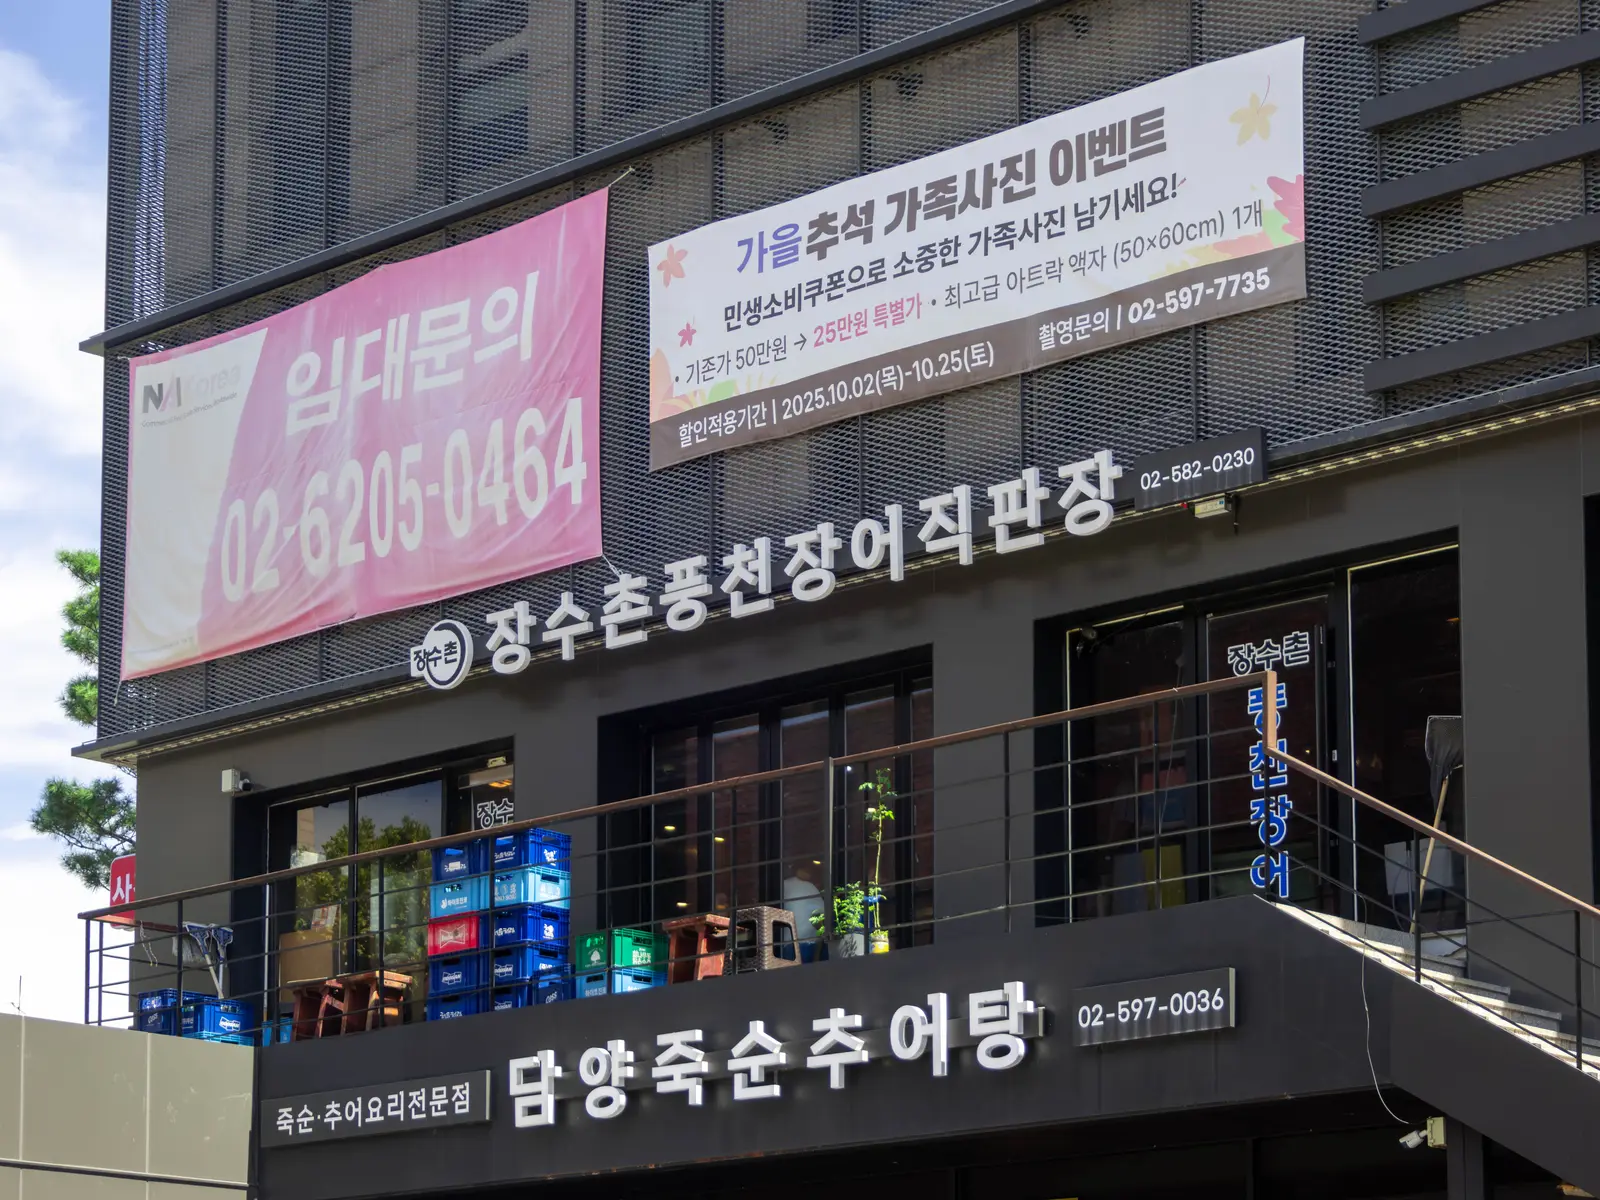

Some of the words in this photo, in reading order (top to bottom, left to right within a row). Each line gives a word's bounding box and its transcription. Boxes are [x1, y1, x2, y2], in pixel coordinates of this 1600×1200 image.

[737, 223, 802, 274] 가을
[806, 199, 875, 261] 추석
[884, 148, 1036, 236] 가족사진
[1049, 106, 1167, 187] 이벤트
[686, 349, 731, 385] 기존가
[735, 335, 787, 370] 50만원
[813, 308, 868, 348] 25만원
[872, 293, 922, 328] 특별가
[944, 273, 1000, 310] 최고급
[1006, 256, 1064, 295] 아트락
[1068, 245, 1107, 277] 액자
[1231, 198, 1263, 228] 1개
[724, 257, 887, 332] 민생소비쿠폰으로
[892, 234, 961, 279] 소중한
[967, 205, 1066, 257] 가족사진
[1073, 172, 1177, 232] 남기세요!
[1038, 306, 1109, 351] 촬영문의
[1128, 267, 1271, 324] 02-597-7735
[285, 270, 540, 436] 임대문의
[679, 401, 766, 448] 할인적용기간
[221, 396, 587, 602] 02-6205-0464
[1140, 447, 1255, 490] 02-582-0230
[412, 640, 459, 672] 장수촌
[1227, 631, 1311, 677] 장수촌
[1078, 988, 1225, 1028] 02-597-0036
